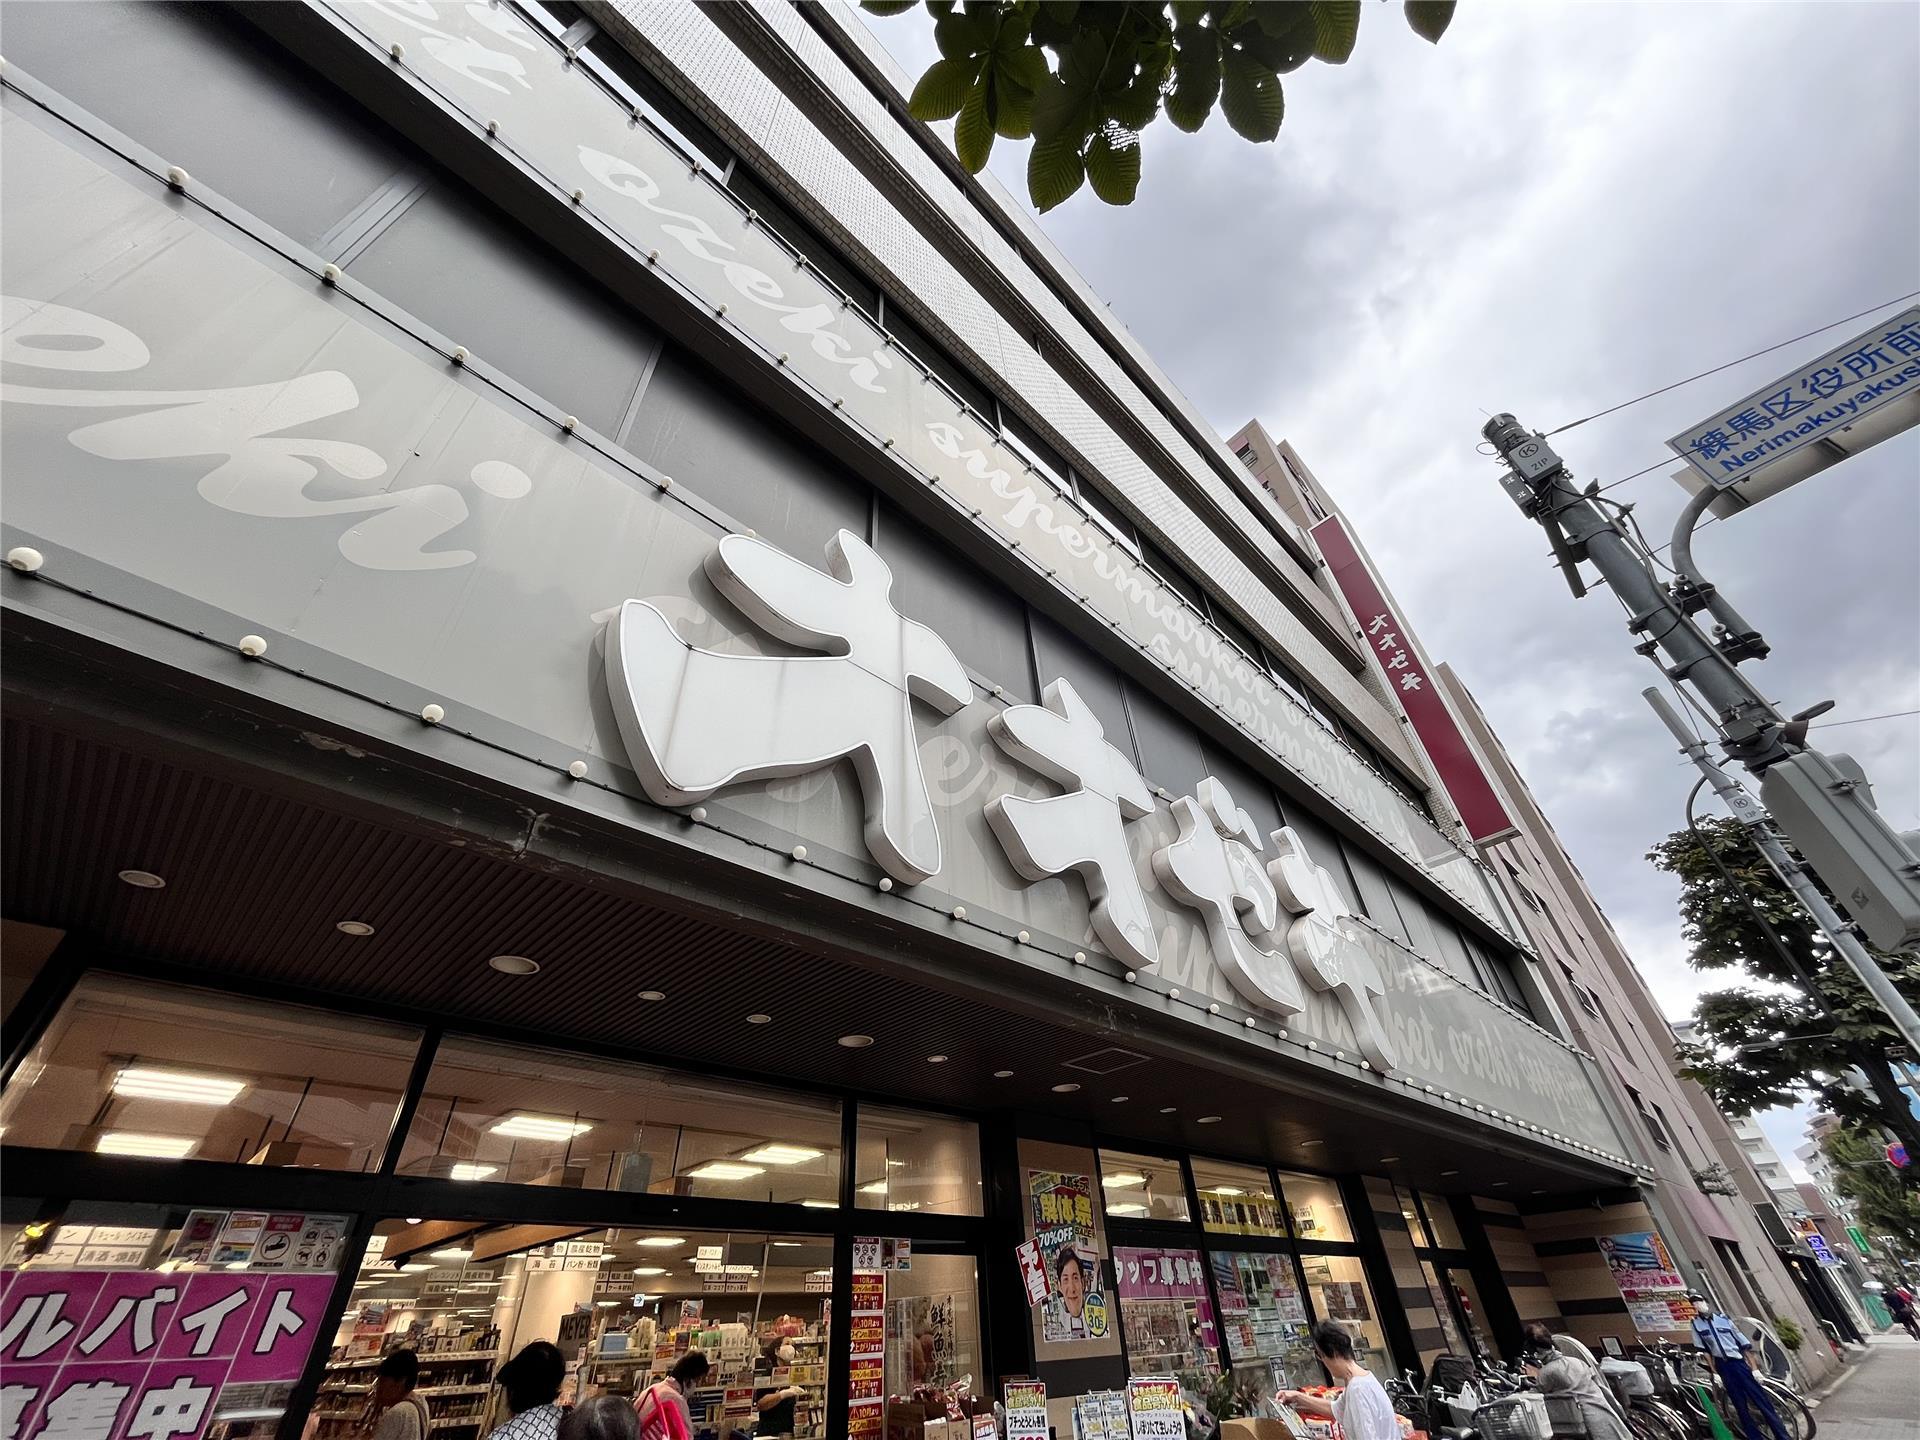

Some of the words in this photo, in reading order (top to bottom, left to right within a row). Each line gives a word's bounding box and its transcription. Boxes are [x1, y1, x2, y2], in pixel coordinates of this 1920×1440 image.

[1367, 612, 1425, 691] オオゼキ
[603, 528, 1398, 1073] オオゼキ
[1019, 1241, 1047, 1303] 予告
